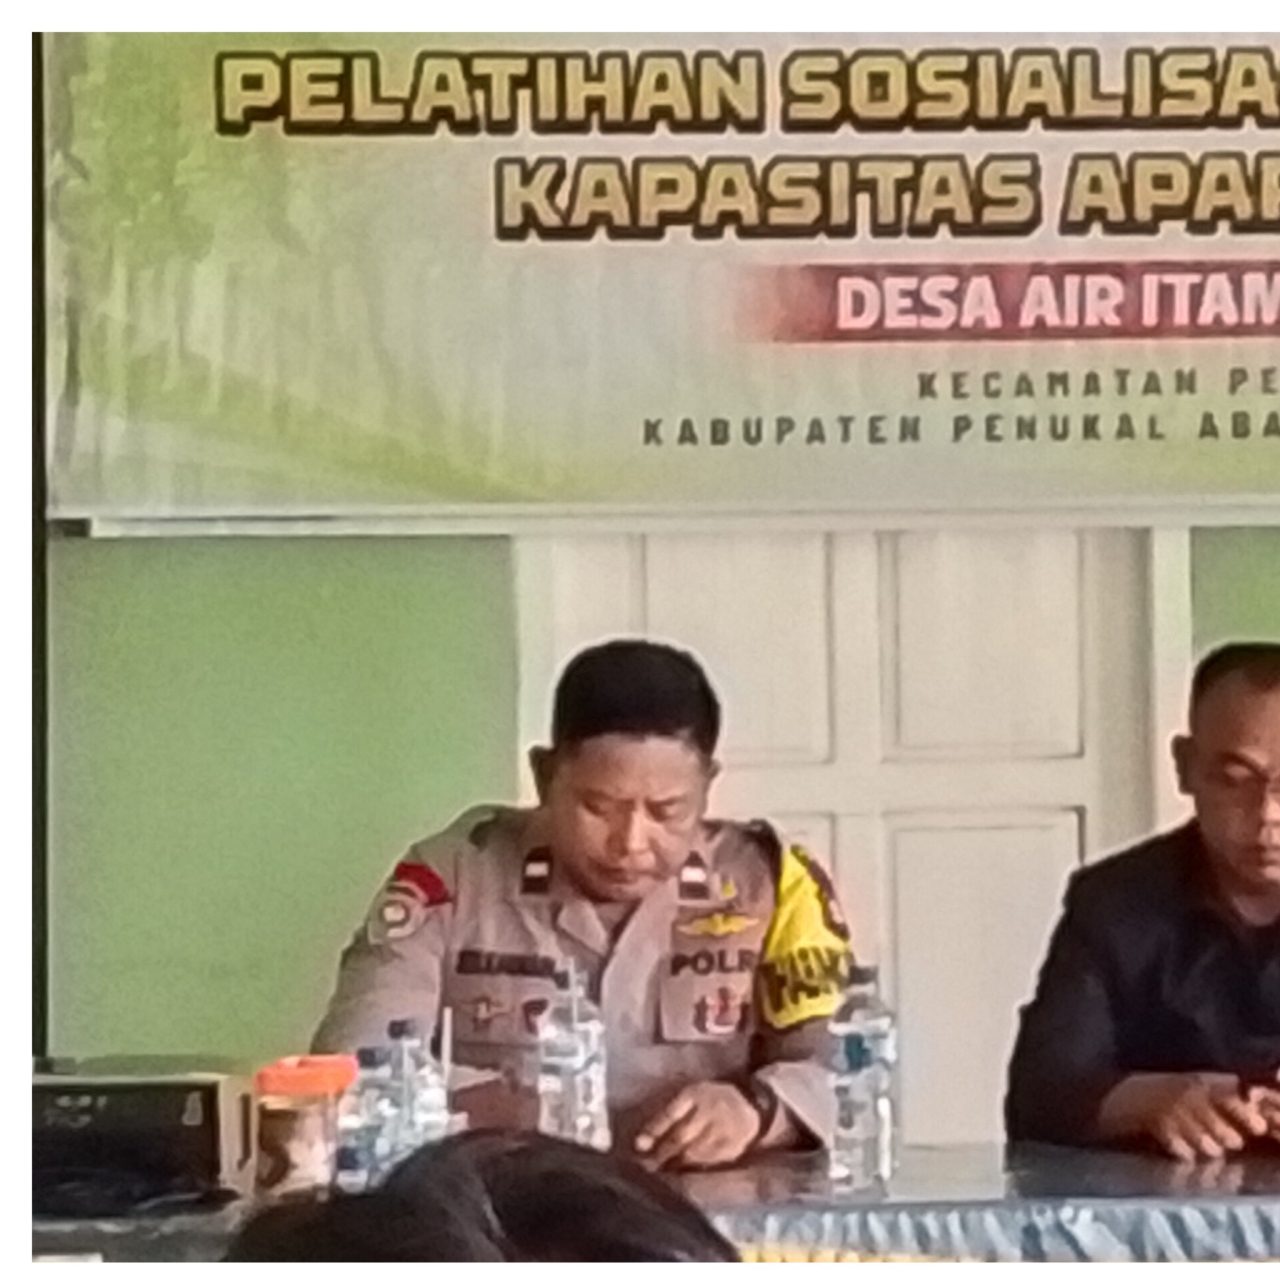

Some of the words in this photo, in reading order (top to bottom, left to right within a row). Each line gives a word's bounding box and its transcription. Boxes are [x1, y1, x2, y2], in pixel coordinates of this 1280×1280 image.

[216, 50, 767, 134] PELATIHAN
[495, 156, 1039, 239] KAPASITAS
[836, 276, 1003, 331] DESA
[1019, 274, 1126, 328] AIR
[918, 368, 1198, 399] KECAMATAN
[642, 415, 921, 446] KABUPATEN
[952, 412, 1166, 444] PENUKAL
[671, 949, 757, 976] POLR
